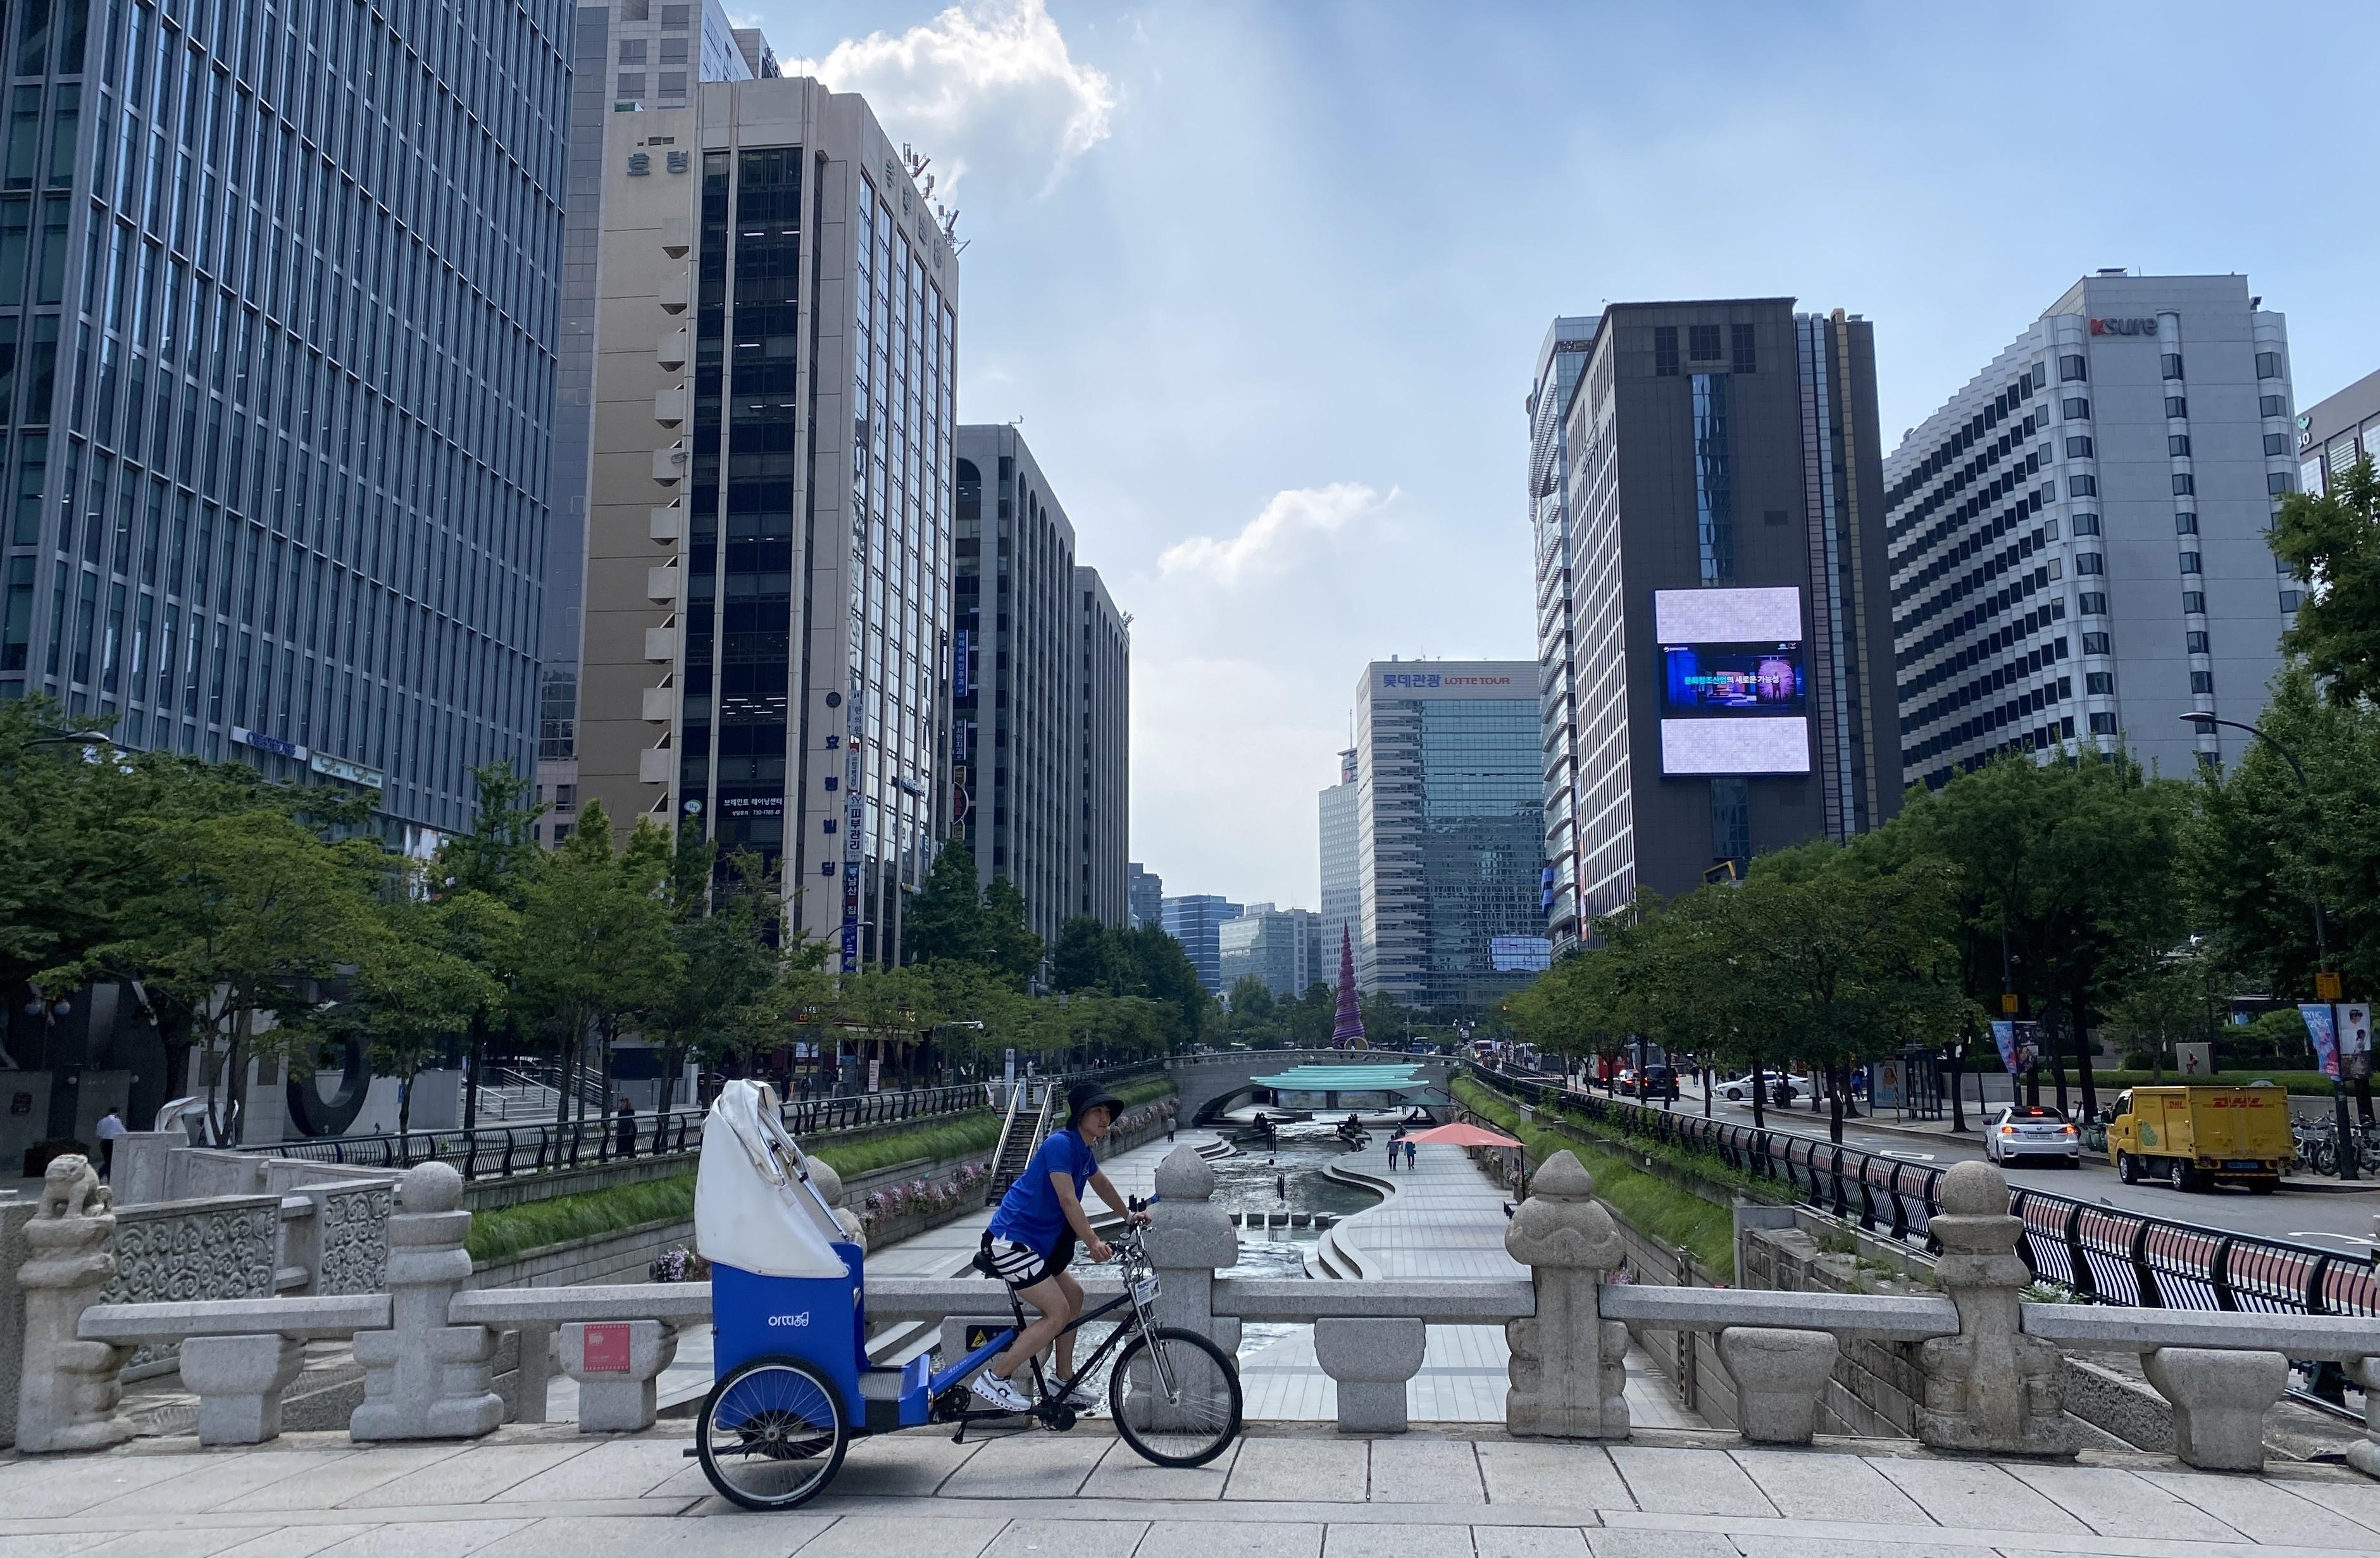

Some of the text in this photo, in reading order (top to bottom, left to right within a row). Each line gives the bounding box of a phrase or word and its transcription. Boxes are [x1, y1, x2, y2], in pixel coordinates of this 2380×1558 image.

[1383, 674, 1441, 688] 롯데관광
[849, 809, 861, 850] 피부관리
[2212, 1098, 2264, 1107] DHL
